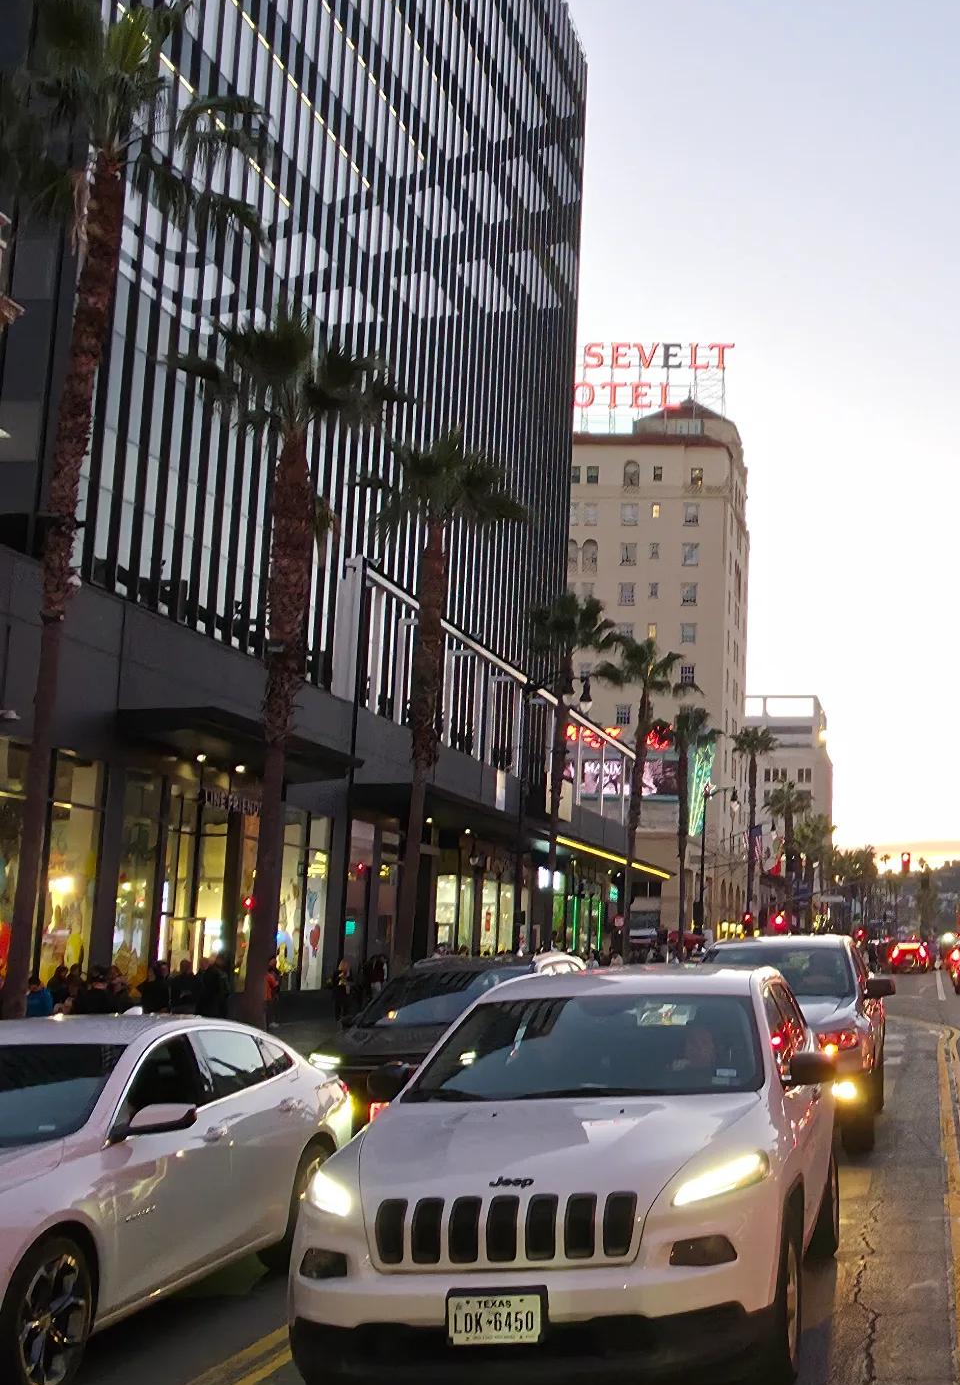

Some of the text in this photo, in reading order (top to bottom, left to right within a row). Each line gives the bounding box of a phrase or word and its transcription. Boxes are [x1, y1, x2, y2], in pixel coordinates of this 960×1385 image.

[573, 381, 681, 409] OTEL
[489, 1176, 535, 1189] Jeep
[476, 1299, 512, 1309] TEXAS
